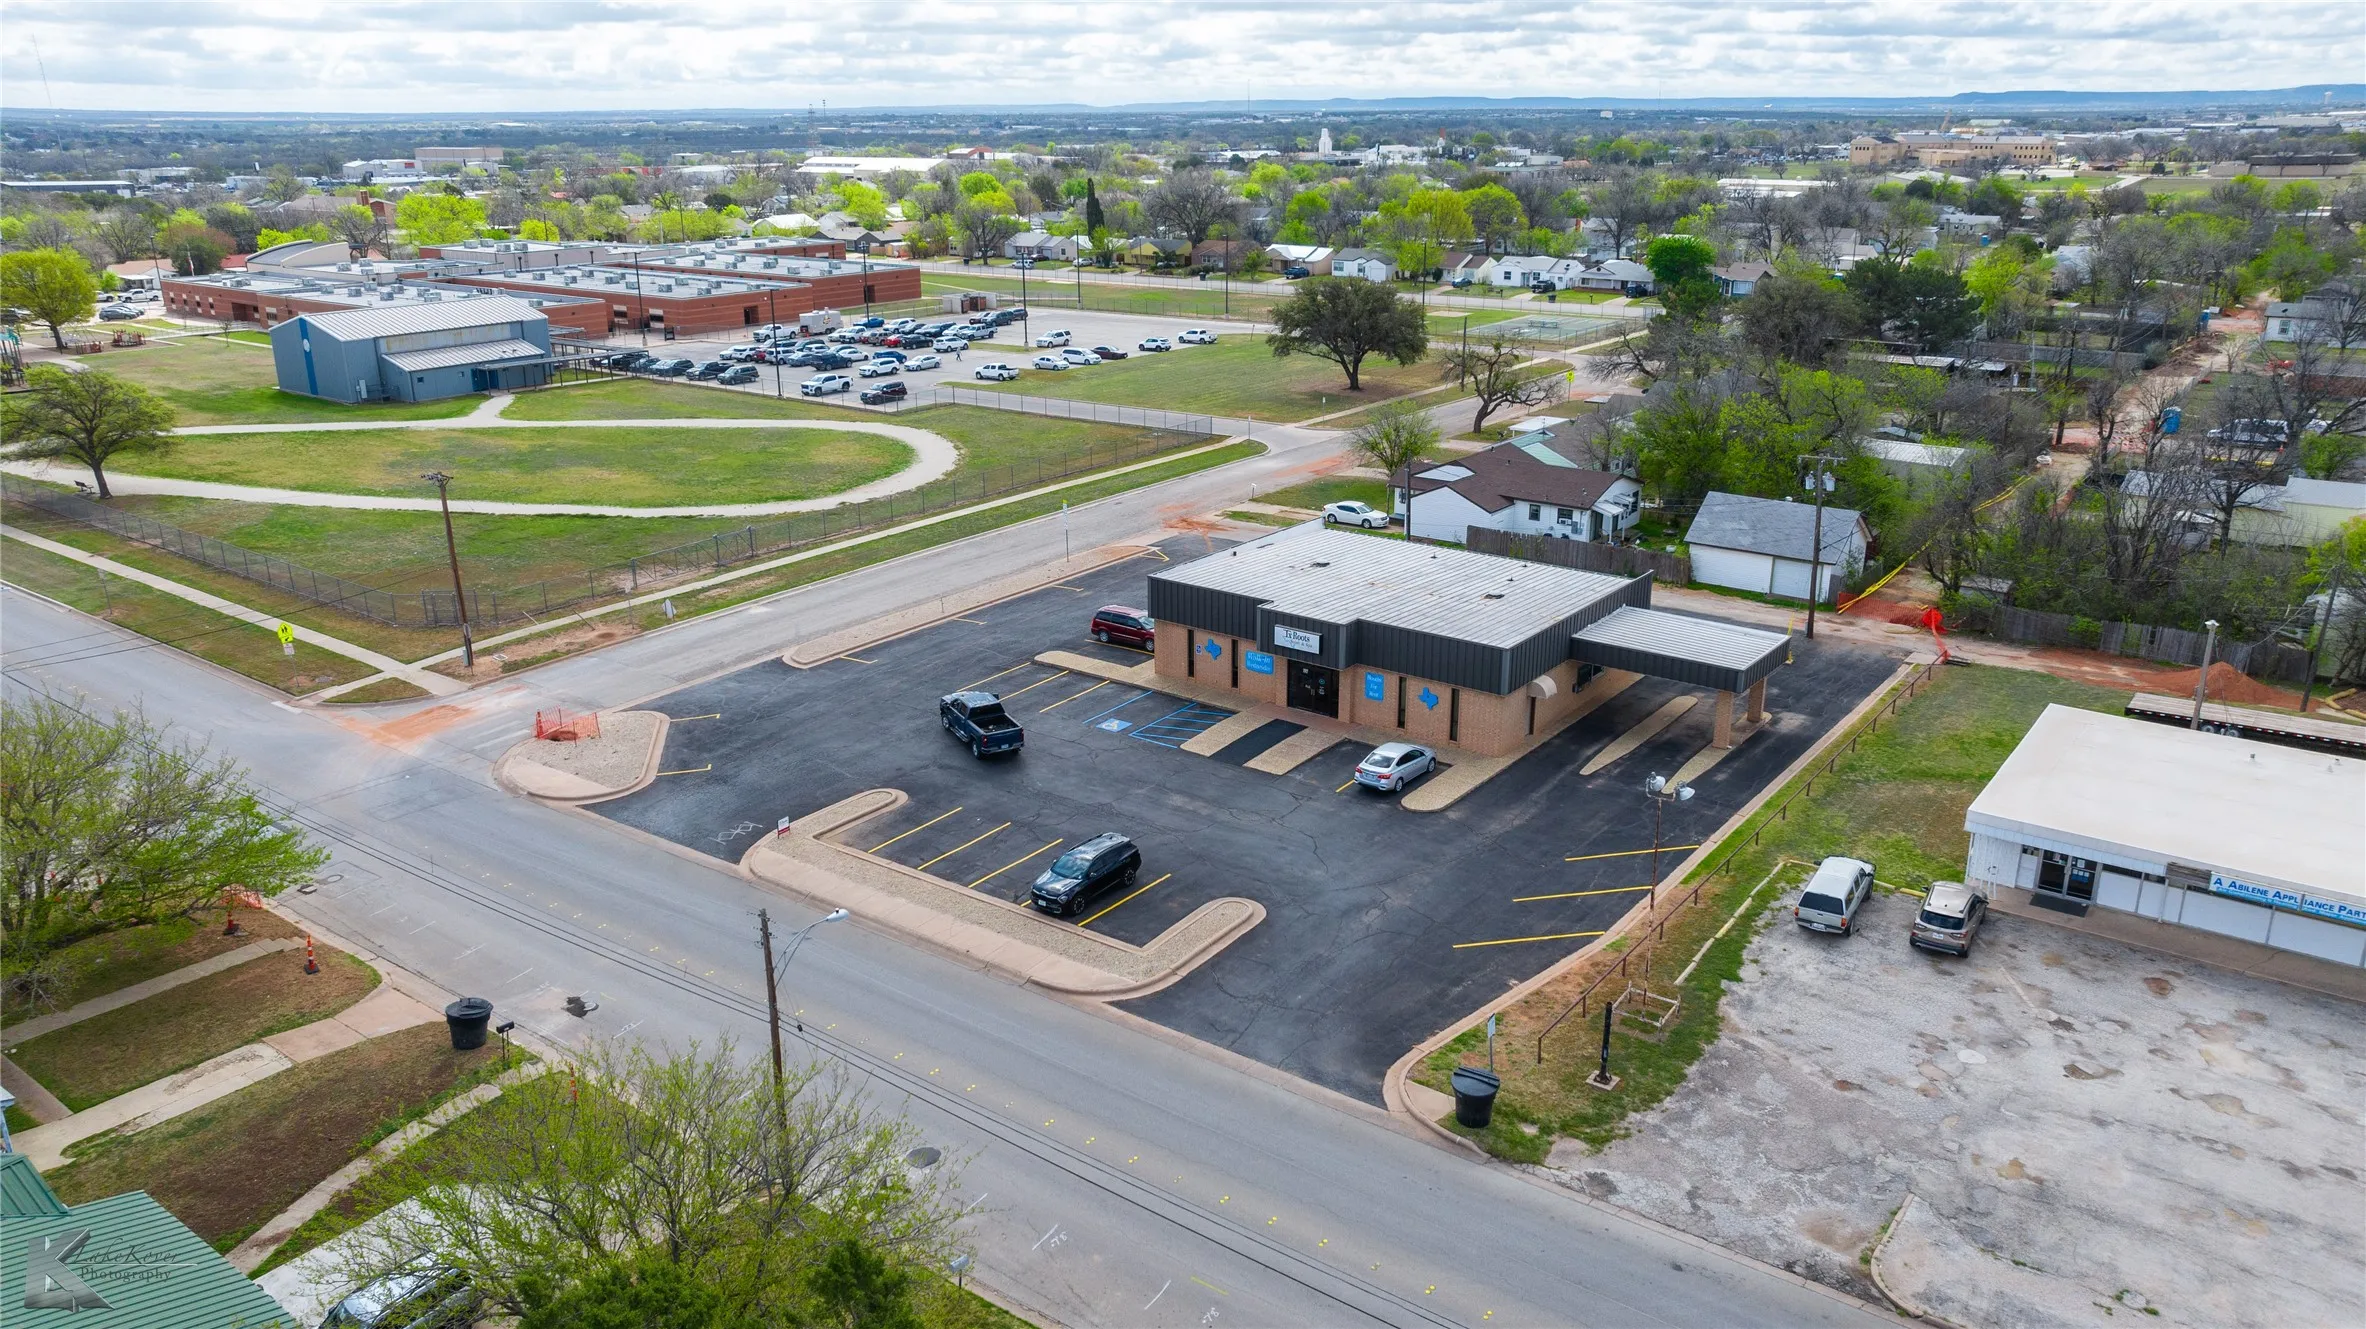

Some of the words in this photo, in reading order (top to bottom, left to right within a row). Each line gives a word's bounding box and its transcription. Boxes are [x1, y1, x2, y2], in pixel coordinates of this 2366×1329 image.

[1292, 631, 1310, 642] Roots
[2213, 877, 2223, 887] A
[2228, 880, 2269, 897] ABILENE
